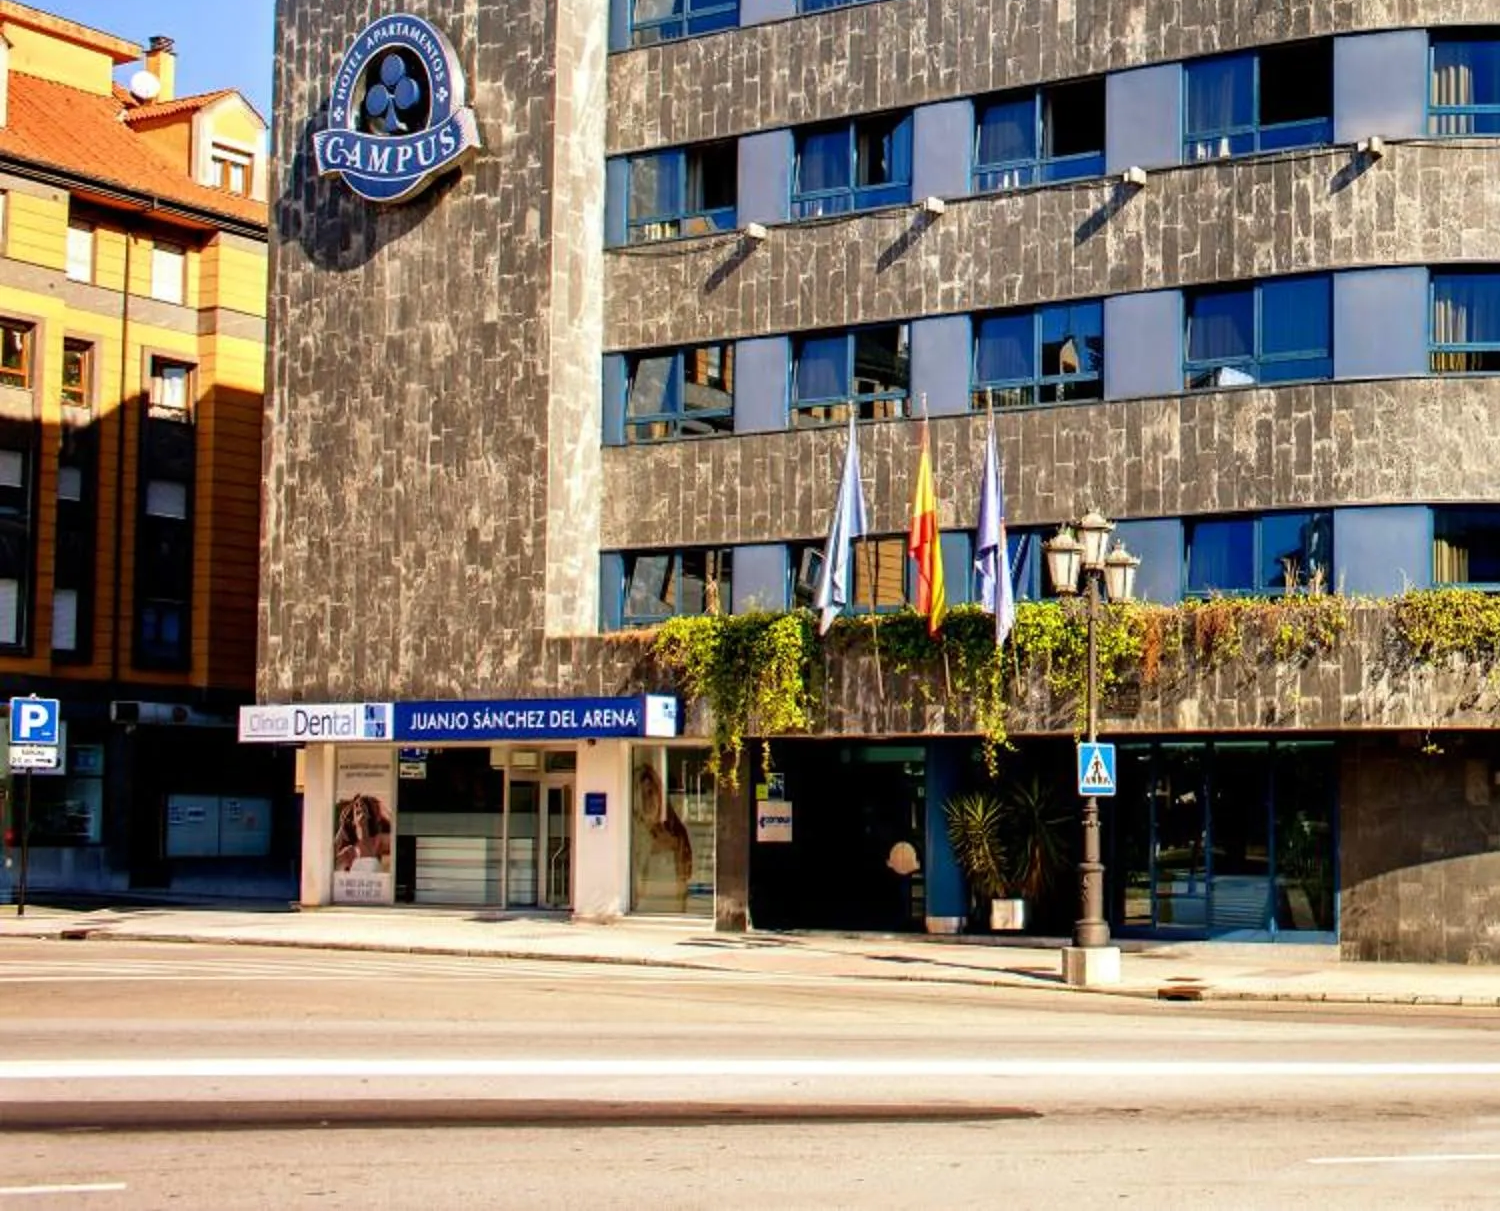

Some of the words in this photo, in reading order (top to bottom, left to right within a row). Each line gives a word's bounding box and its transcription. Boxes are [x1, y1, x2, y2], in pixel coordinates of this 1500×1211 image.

[337, 52, 362, 100] HOTEL
[366, 22, 445, 82] APARTAMENTOS
[326, 126, 457, 174] CAMPUS
[20, 703, 49, 738] P
[294, 708, 357, 736] Dental
[410, 712, 468, 730] JUANJO
[474, 707, 544, 729] SÁNCHEZ
[550, 710, 578, 728] DEL
